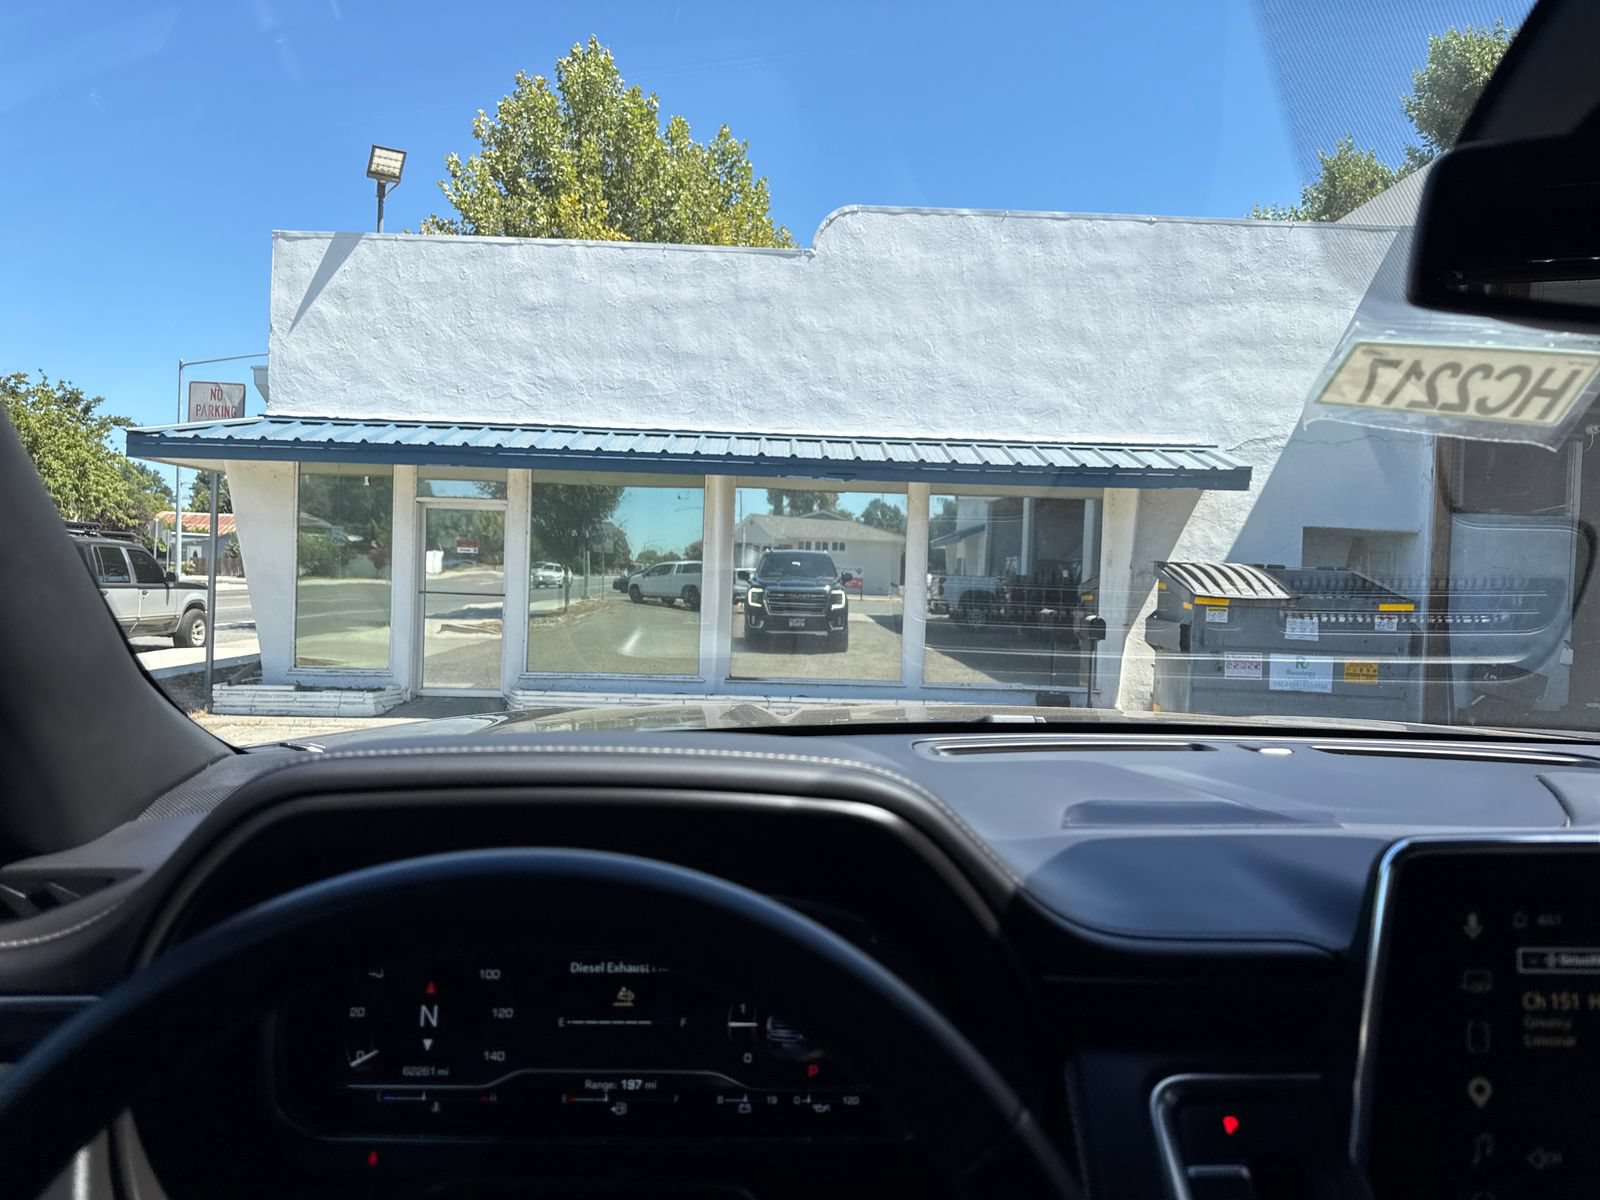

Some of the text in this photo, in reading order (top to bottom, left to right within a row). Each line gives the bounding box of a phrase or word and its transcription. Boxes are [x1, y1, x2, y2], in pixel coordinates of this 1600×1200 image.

[210, 388, 223, 401] NO
[195, 404, 237, 418] PARKING
[569, 961, 606, 974] Diesel
[479, 968, 501, 980] 100
[349, 1006, 366, 1018] 20
[491, 1007, 514, 1019] 120
[740, 1003, 747, 1015] 1
[420, 1004, 439, 1027] N
[482, 1050, 506, 1063] 140
[743, 1052, 753, 1064] 0
[437, 1066, 449, 1077] mi
[584, 1078, 657, 1092] Range: 197 mi
